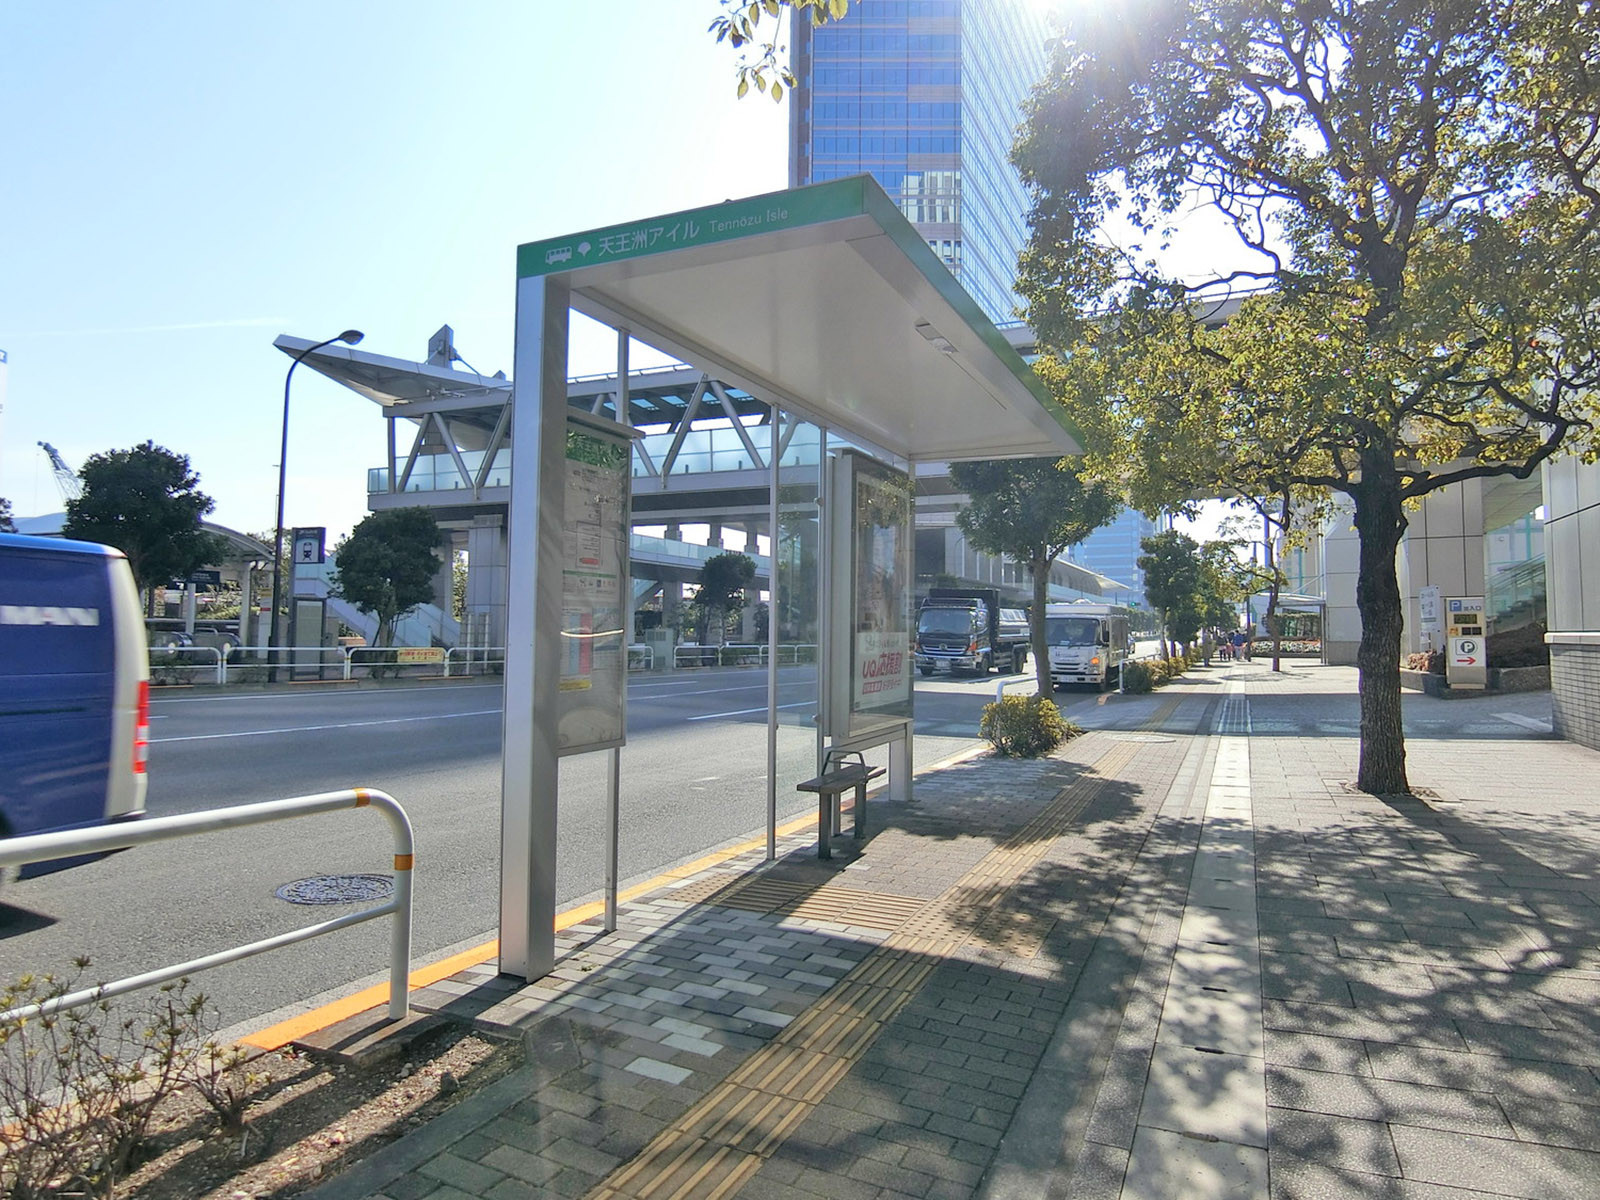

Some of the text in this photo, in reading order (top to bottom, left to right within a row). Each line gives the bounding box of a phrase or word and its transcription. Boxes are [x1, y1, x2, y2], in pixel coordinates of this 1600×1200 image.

[598, 221, 700, 257] 天王洲アイル
[766, 207, 788, 222] Isle
[1451, 601, 1460, 611] P
